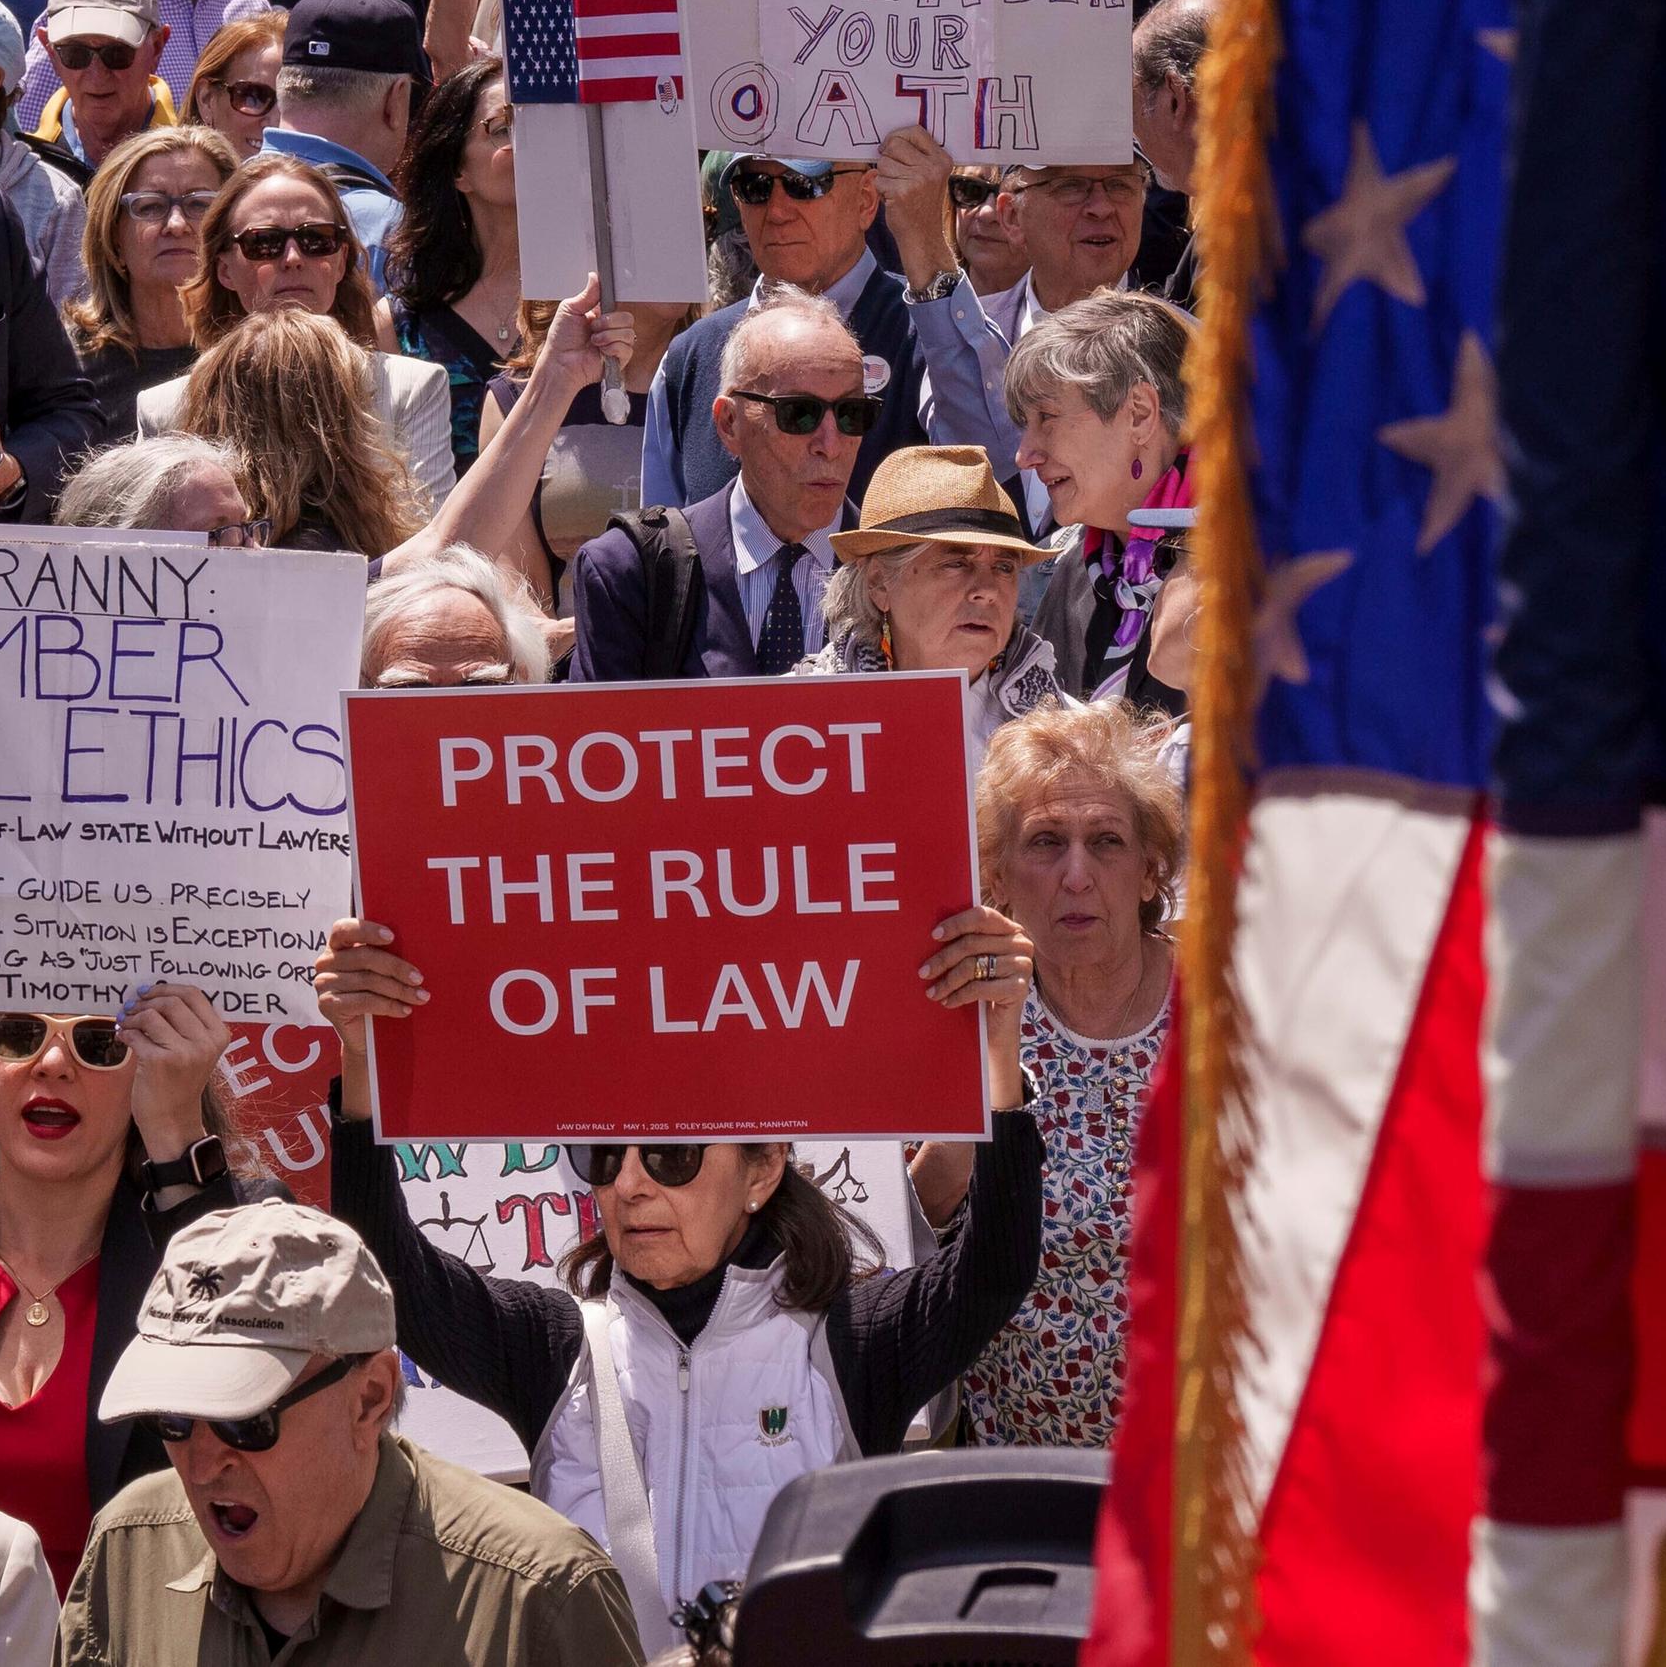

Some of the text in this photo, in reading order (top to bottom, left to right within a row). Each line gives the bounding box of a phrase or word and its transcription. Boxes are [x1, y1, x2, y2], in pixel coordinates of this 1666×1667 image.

[787, 4, 970, 72] YOUR
[710, 61, 1039, 150] OATH
[61, 706, 349, 815] ETHICS
[440, 722, 883, 807] PROTECT
[80, 822, 152, 843] STATE
[154, 820, 253, 848] WITHOUT
[17, 878, 102, 903] GUIDE
[170, 882, 310, 910] PRECISELY
[427, 842, 901, 925] THE RULE
[14, 913, 136, 943] SITUATION
[146, 925, 168, 943] IS
[172, 916, 327, 951] EXCEPTIONA
[39, 952, 75, 970] AS
[149, 949, 272, 979] FOLLOWING
[489, 960, 862, 1037] OF LAW
[556, 1123, 615, 1131] LAW DAY RALLY
[650, 1122, 670, 1130] 2025
[675, 1120, 808, 1130] FOLEY SQUARE PARK, MANHATTAN
[215, 1315, 285, 1331] Association
